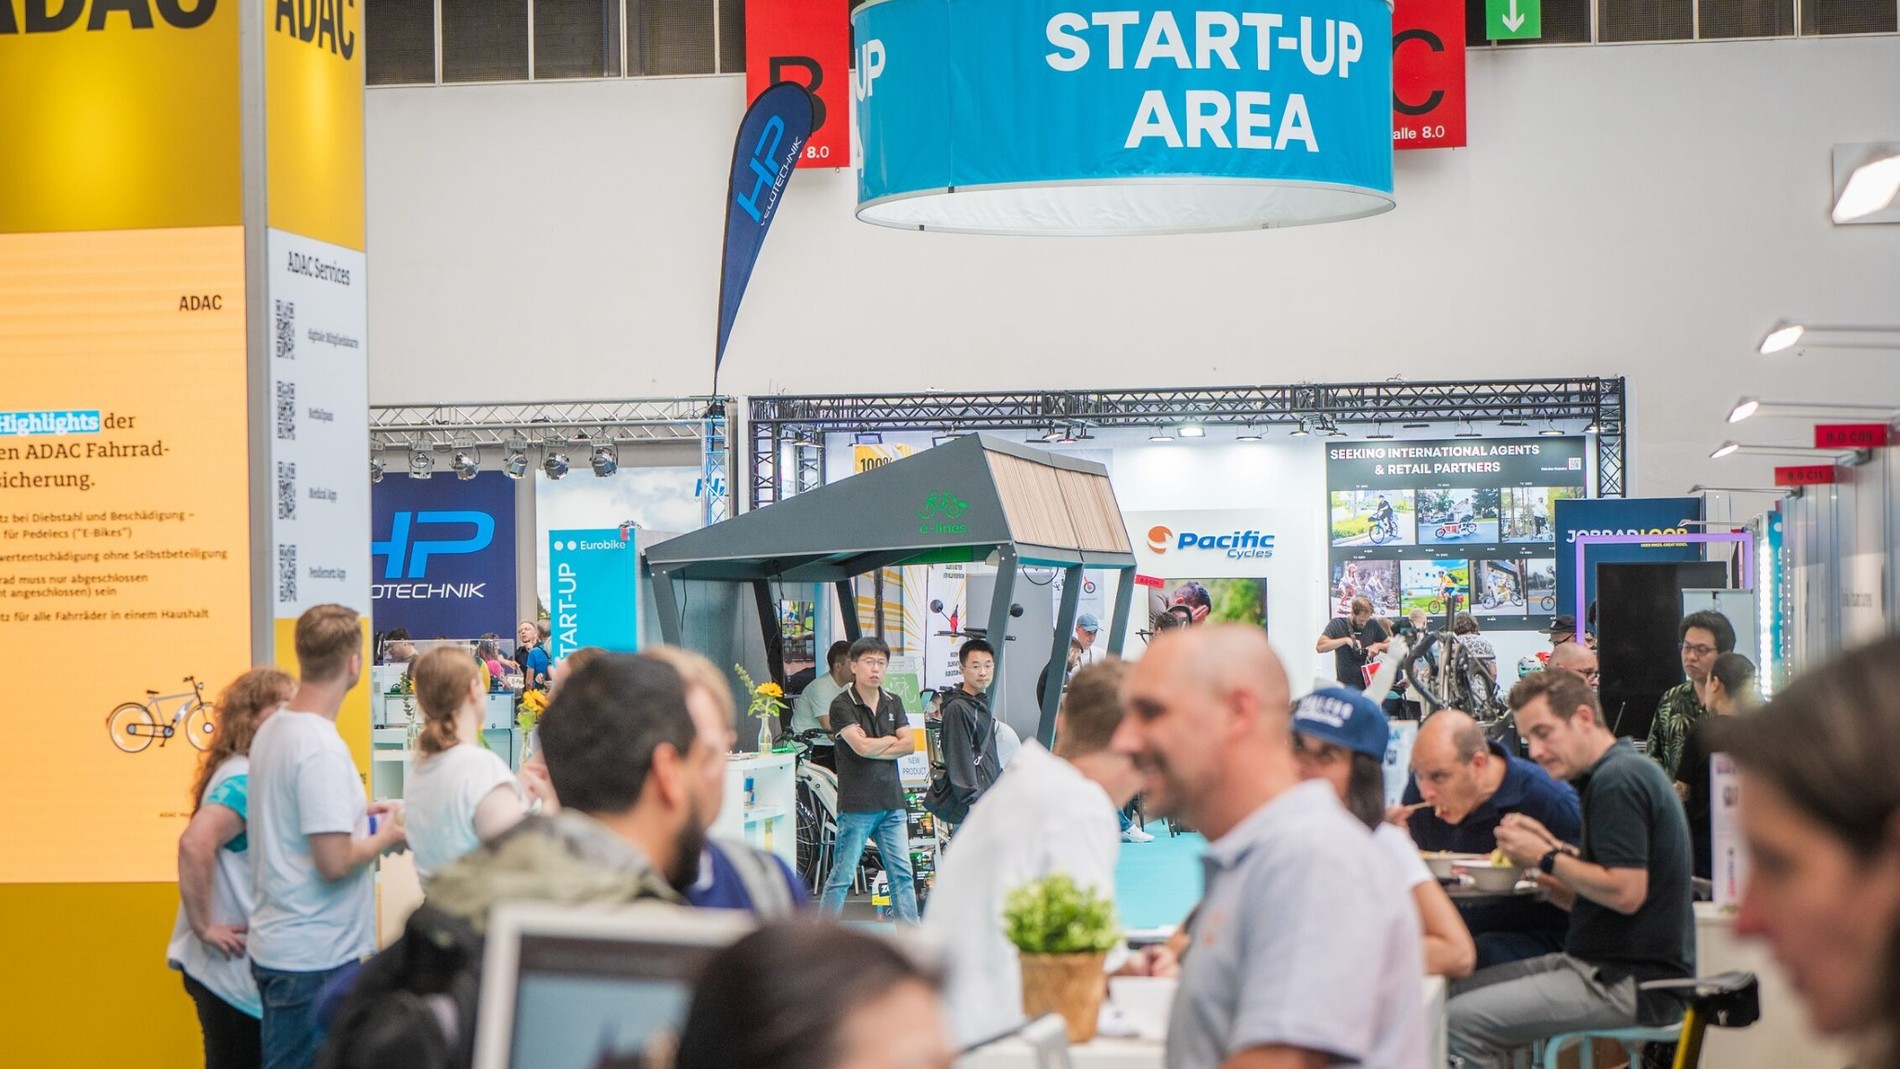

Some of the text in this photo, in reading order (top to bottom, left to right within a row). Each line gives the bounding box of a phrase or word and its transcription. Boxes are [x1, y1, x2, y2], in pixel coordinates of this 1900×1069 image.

[1045, 10, 1363, 78] START-UP
[1393, 29, 1445, 116] C
[1124, 90, 1319, 152] AREA
[1422, 125, 1445, 138] 8.0
[806, 146, 829, 159] 8.0
[736, 115, 785, 223] HP
[287, 251, 350, 286] ADAC Services
[179, 295, 223, 312] ADAC
[0, 413, 136, 436] Highlights der
[25, 443, 81, 460] ADAC
[86, 440, 170, 459] Fahrrad-
[1330, 444, 1540, 460] SEEKING INTERNATIONAL AGENTS
[1374, 462, 1501, 475] & RETAIL PARTNERS
[12, 512, 29, 523] bei
[32, 511, 83, 523] Diebstahl
[86, 512, 107, 522] und
[110, 509, 185, 522] Beschädigung
[4, 529, 19, 539] für
[22, 528, 69, 539] Pedelecs
[919, 523, 967, 535] e-lines
[580, 540, 626, 551] Eurobike
[1177, 530, 1275, 550] Pacific
[103, 549, 130, 560] ohne
[133, 548, 228, 561] Selbstbeteiligung
[1227, 549, 1273, 560] Cycles
[19, 576, 46, 584] muss
[49, 576, 67, 584] nur
[71, 573, 148, 585] abgeschlossen
[10, 587, 92, 599] angeschlossen)
[95, 586, 117, 596] sein
[14, 611, 29, 621] für
[33, 611, 51, 621] alle
[55, 610, 107, 621] Fahrräder
[110, 610, 121, 620] in
[124, 609, 158, 620] einem
[161, 608, 209, 619] Haushalt
[908, 757, 920, 765] NEW
[902, 768, 927, 776] PRODUCT
